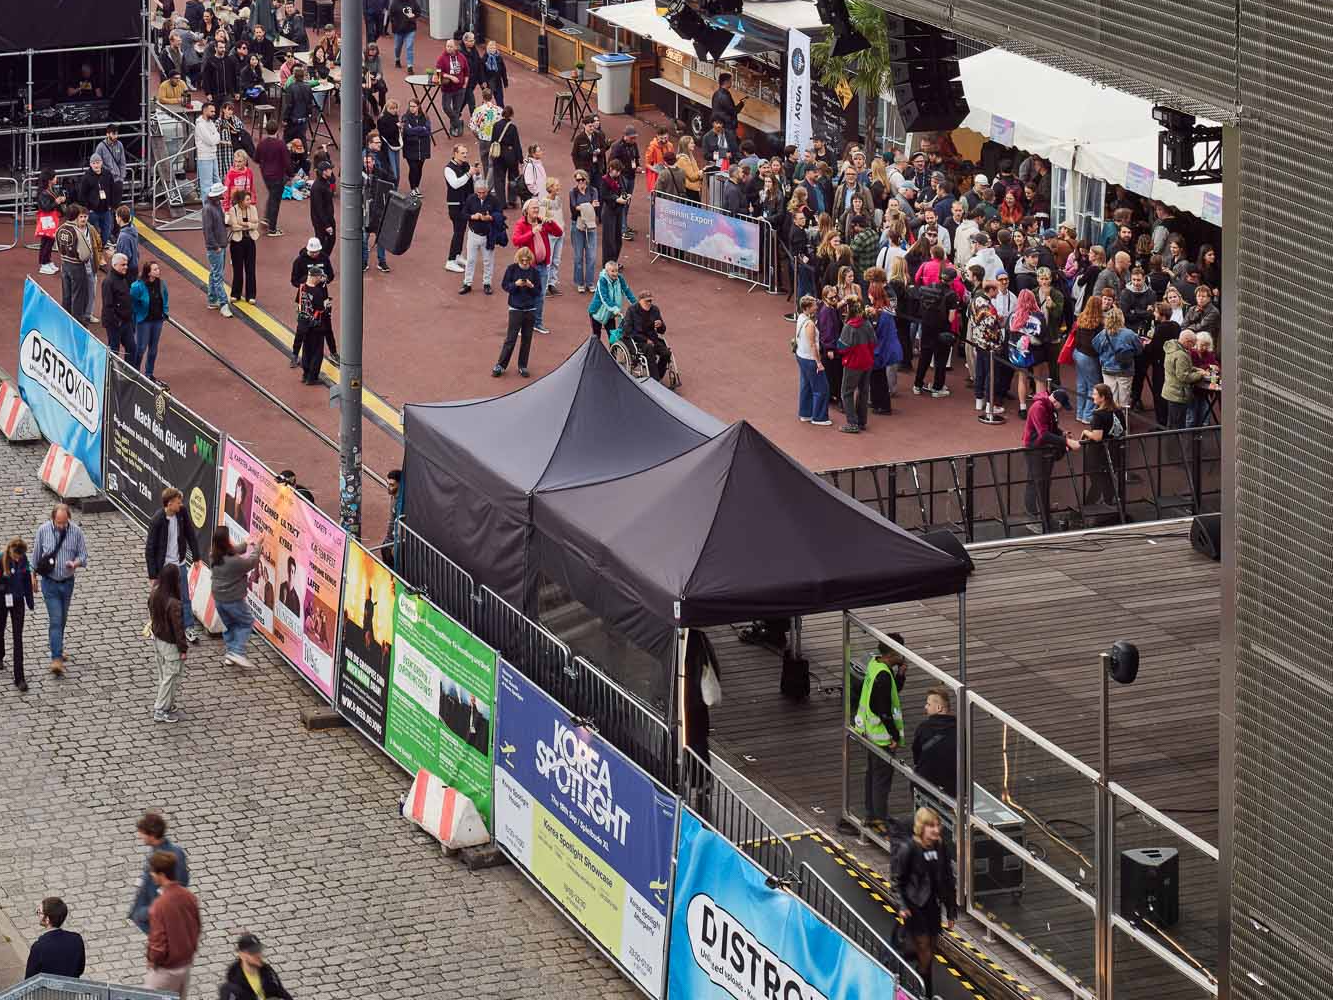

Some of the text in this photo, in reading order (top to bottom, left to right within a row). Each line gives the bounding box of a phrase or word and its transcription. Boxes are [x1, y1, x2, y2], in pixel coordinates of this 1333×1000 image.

[690, 212, 714, 225] Export
[134, 403, 152, 430] Mach
[165, 429, 187, 459] Glück!
[286, 523, 300, 539] TRACY
[553, 719, 613, 799] KOREA
[535, 739, 631, 846] SPOTLIGHT
[580, 819, 603, 844] Spielbude
[543, 818, 559, 837] Korea
[559, 832, 584, 862] Spotlight
[584, 856, 614, 888] Showcase
[724, 969, 744, 993] uploads
